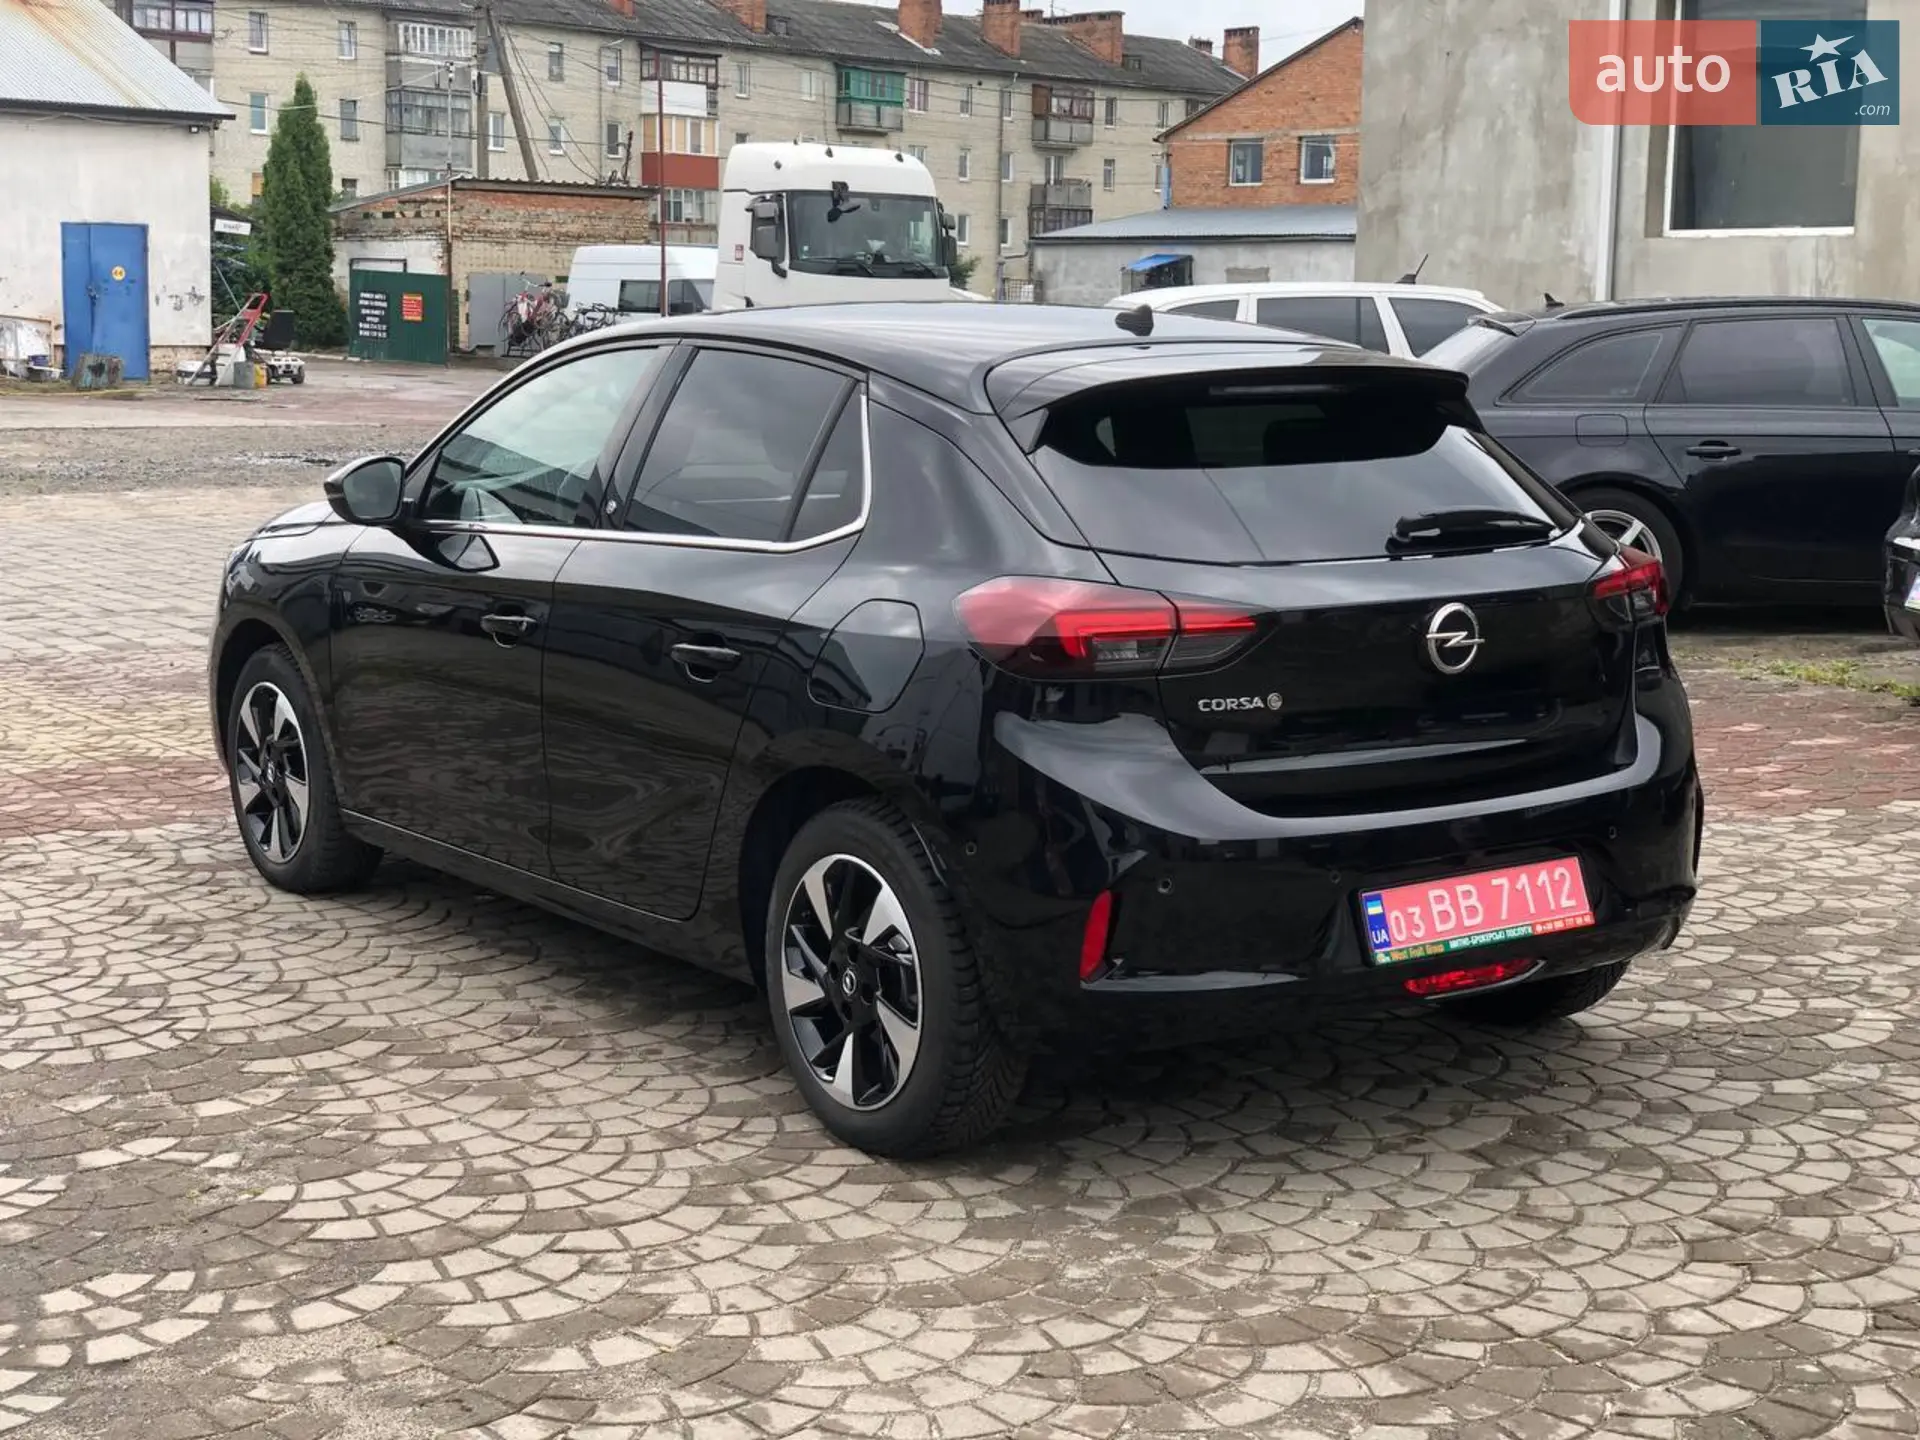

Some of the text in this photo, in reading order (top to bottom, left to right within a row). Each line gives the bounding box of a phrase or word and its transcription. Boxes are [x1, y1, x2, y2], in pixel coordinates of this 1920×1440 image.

[1198, 696, 1265, 712] CORSA
[1390, 866, 1577, 943] 03 BB 7112
[1371, 928, 1389, 944] UA
